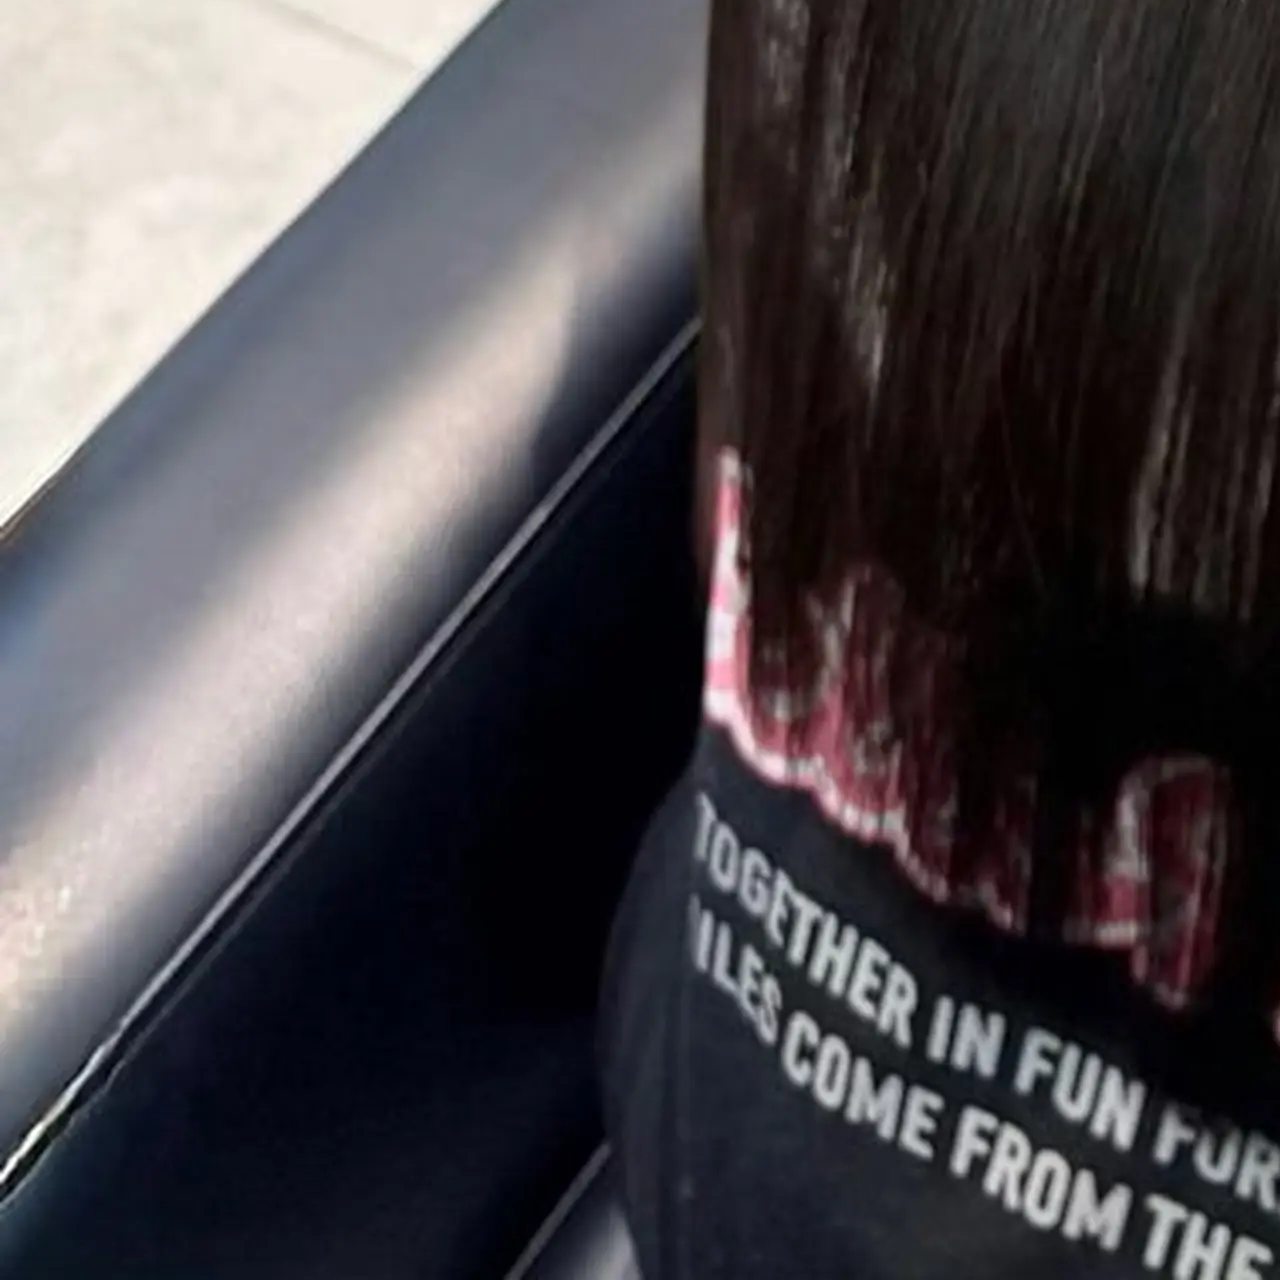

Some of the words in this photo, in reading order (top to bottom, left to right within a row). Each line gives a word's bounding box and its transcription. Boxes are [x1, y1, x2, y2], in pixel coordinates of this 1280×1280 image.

[695, 790, 912, 1049] TOGETHER
[926, 994, 1006, 1080] IN
[1013, 1026, 1146, 1153] FUN
[781, 1009, 945, 1161] COME
[950, 1104, 1134, 1252] FROM
